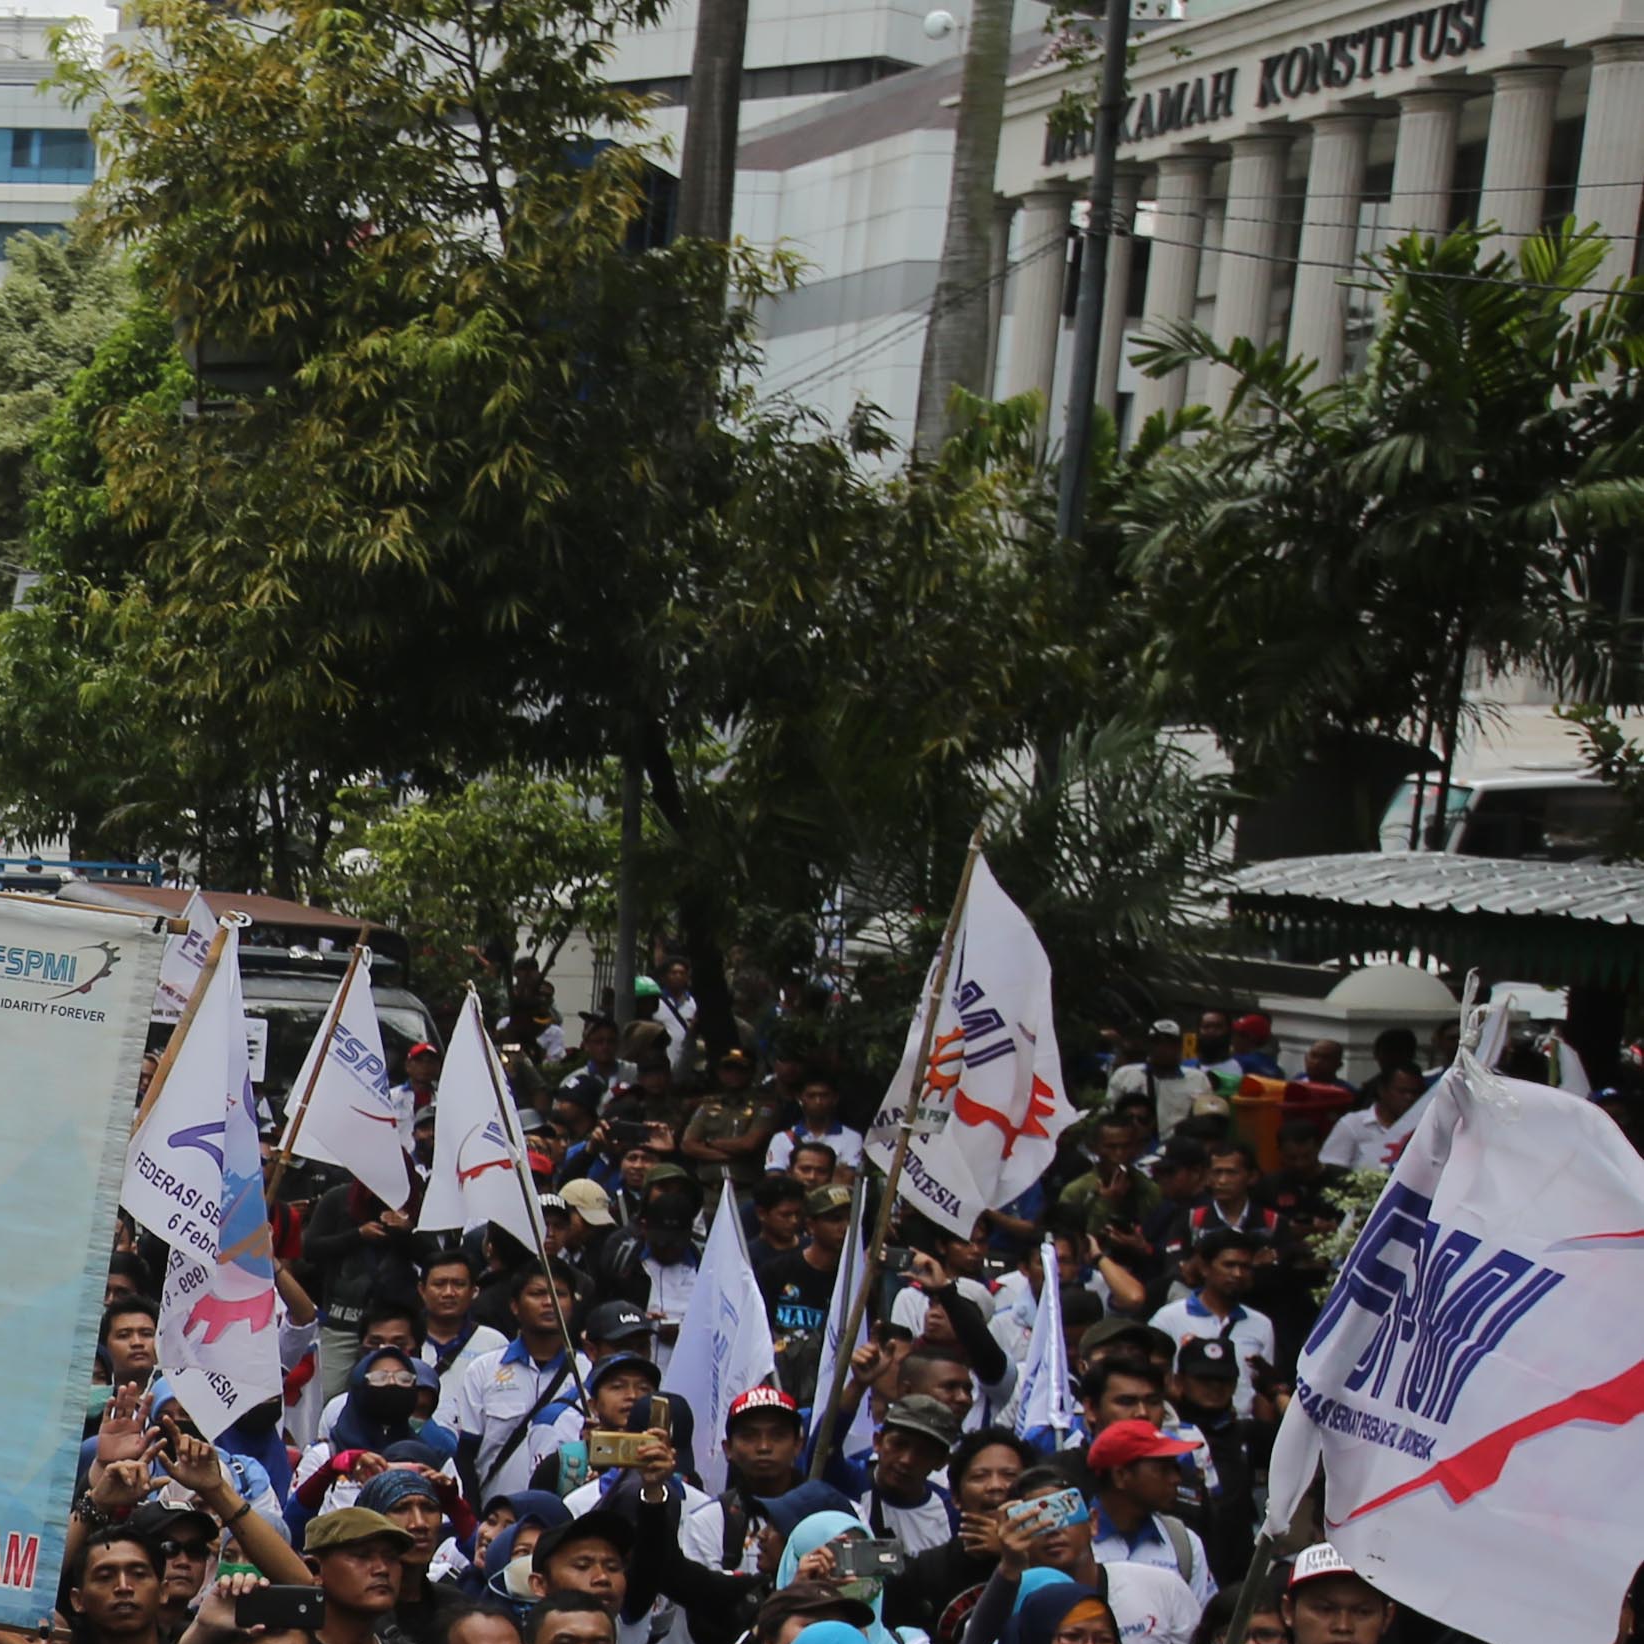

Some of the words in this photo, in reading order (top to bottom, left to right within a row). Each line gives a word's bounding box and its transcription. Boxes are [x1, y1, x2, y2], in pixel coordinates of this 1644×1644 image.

[1255, 0, 1487, 108] KONSTITUSI
[50, 1004, 106, 1023] FOREVER
[134, 1150, 203, 1209] FEDERASI
[167, 1213, 182, 1231] 6
